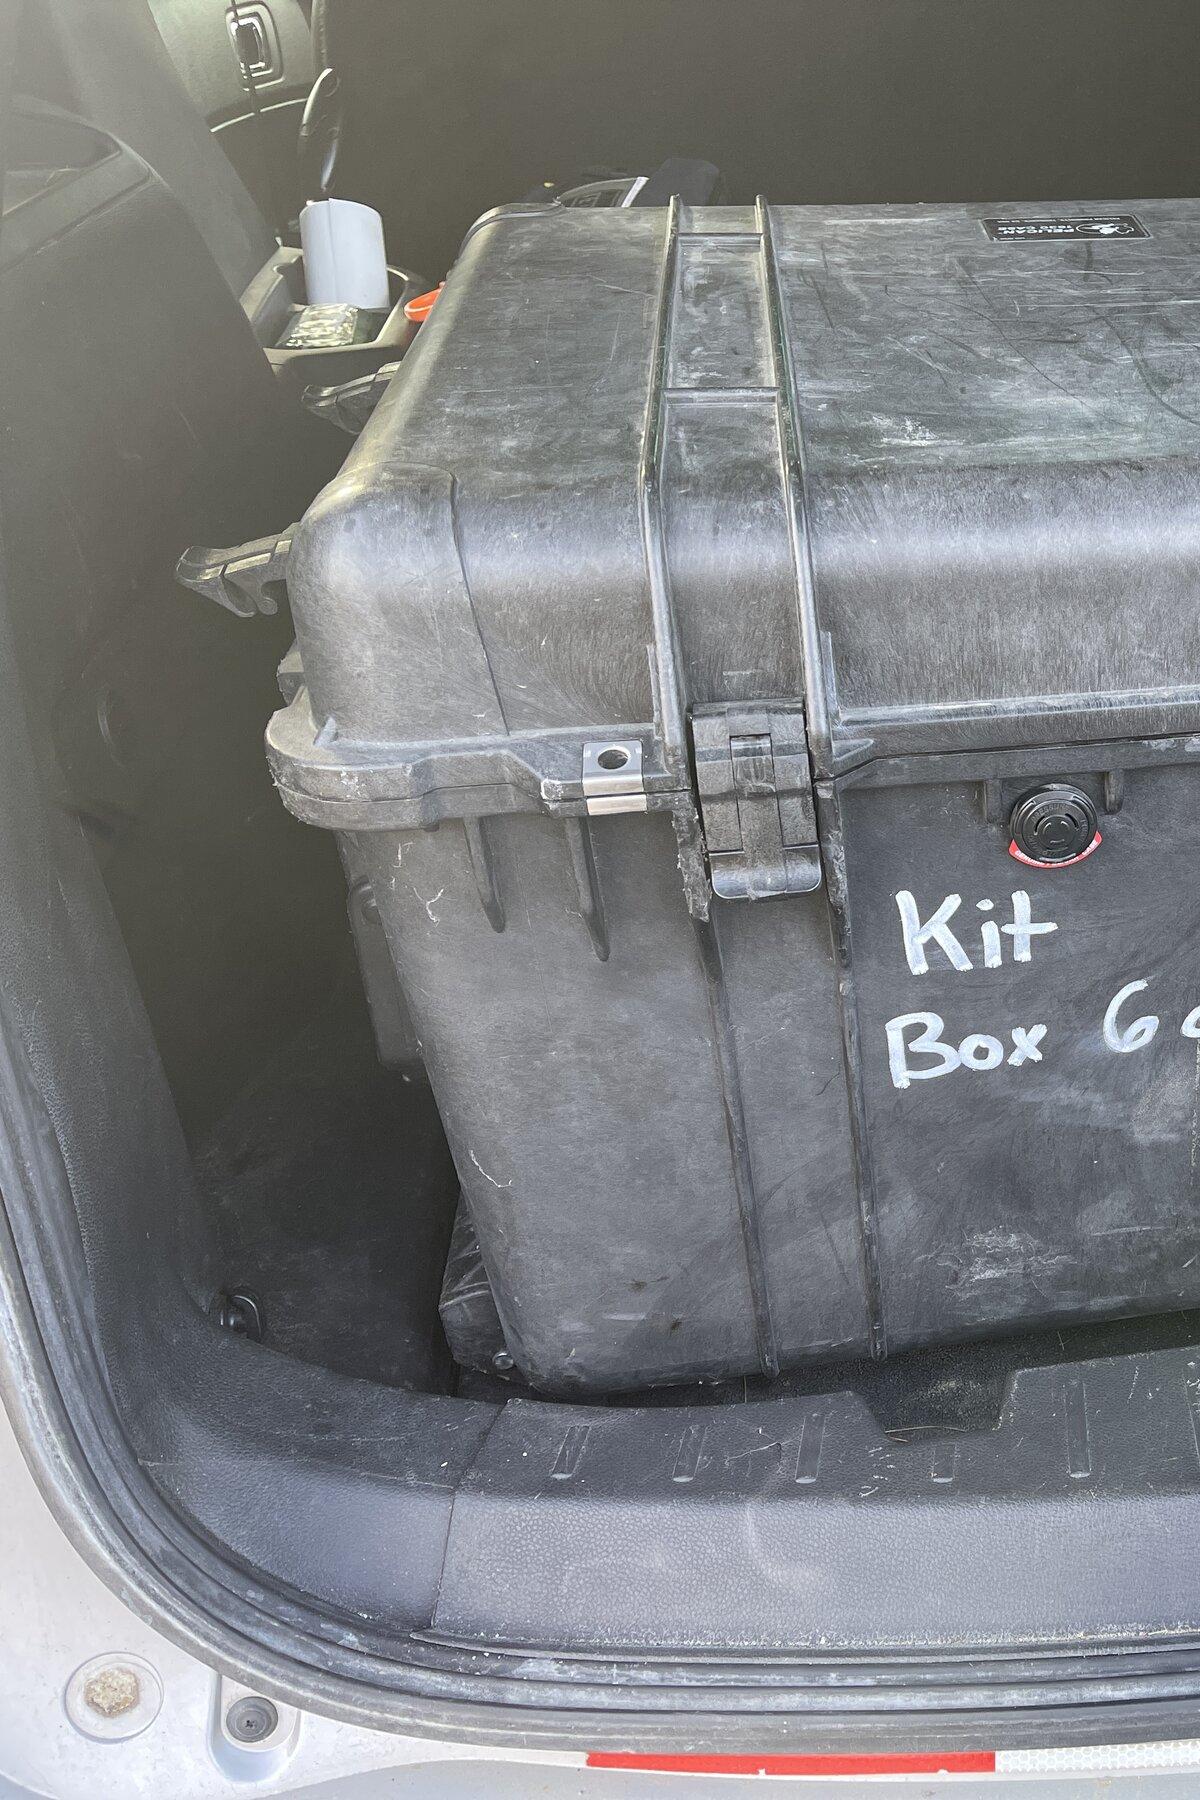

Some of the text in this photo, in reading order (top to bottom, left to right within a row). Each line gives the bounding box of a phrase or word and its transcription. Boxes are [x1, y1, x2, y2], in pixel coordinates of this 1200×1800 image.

[895, 889, 1059, 975] Kit
[885, 1011, 1048, 1089] Box
[1101, 979, 1160, 1054] 6
